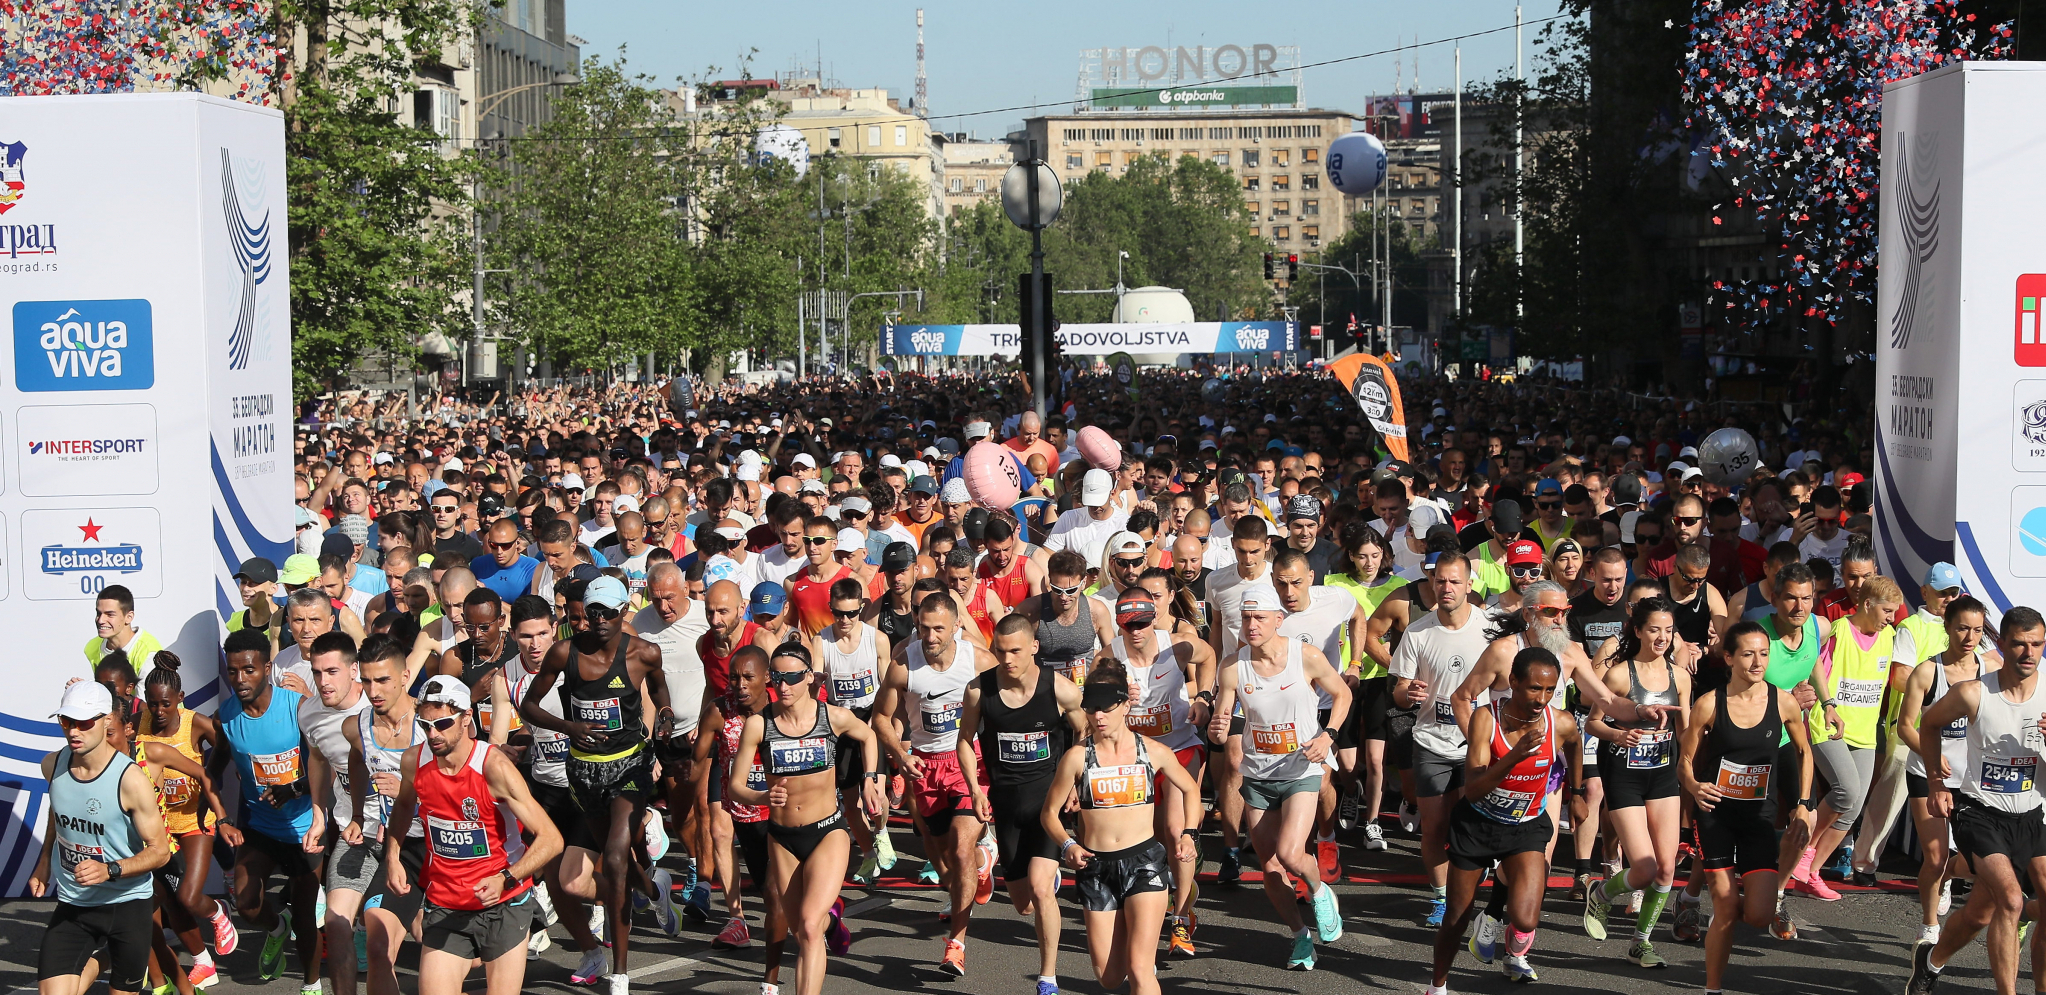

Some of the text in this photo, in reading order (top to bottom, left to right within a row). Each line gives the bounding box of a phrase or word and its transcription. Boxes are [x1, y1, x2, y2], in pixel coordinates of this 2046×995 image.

[1102, 43, 1279, 81] HONOR
[1173, 88, 1225, 104] otpbanka
[40, 320, 128, 350] aqua
[886, 326, 894, 355] START
[911, 331, 945, 344] aqua
[990, 331, 1190, 347] TRK ADOVOLJSTVA
[1235, 327, 1270, 340] aqua
[1286, 322, 1294, 351] START
[913, 342, 942, 353] viva
[1238, 338, 1267, 350] viva
[46, 349, 122, 378] viva
[1899, 375, 1934, 402] БЕОГРАДСКИ
[232, 393, 274, 419] 35. БЕОГРАДСКИ
[1891, 404, 1933, 440] МАРАТОН
[1378, 424, 1402, 436] GARMIN
[45, 439, 145, 455] INTERSPORT
[233, 422, 275, 458] МАРАТОН
[1720, 450, 1750, 475] 1:35
[998, 454, 1021, 488] 1:25
[46, 549, 137, 569] Heineken
[80, 575, 105, 595] 0.0
[838, 680, 861, 691] 2139
[596, 700, 615, 708] iDEA
[1150, 705, 1169, 714] iDEA
[580, 708, 609, 720] 6959
[930, 710, 957, 724] 6862
[1127, 716, 1157, 727] 0049
[1274, 723, 1292, 731] iDEA
[802, 738, 821, 747] iDEA
[1256, 731, 1282, 744] 0130
[541, 740, 569, 754] 2402
[1011, 740, 1037, 752] 6916
[1634, 744, 1660, 757] 3132
[784, 748, 814, 763] 6873
[2014, 757, 2034, 765] iDEA
[262, 760, 293, 775] 0002
[1121, 766, 1141, 775] iDEA
[1984, 765, 2019, 781] 2545
[1097, 777, 1128, 794] 0167
[1728, 773, 1759, 787] 0865
[457, 822, 479, 830] iDEA
[817, 816, 835, 829] NIKE
[440, 830, 474, 845] 6205
